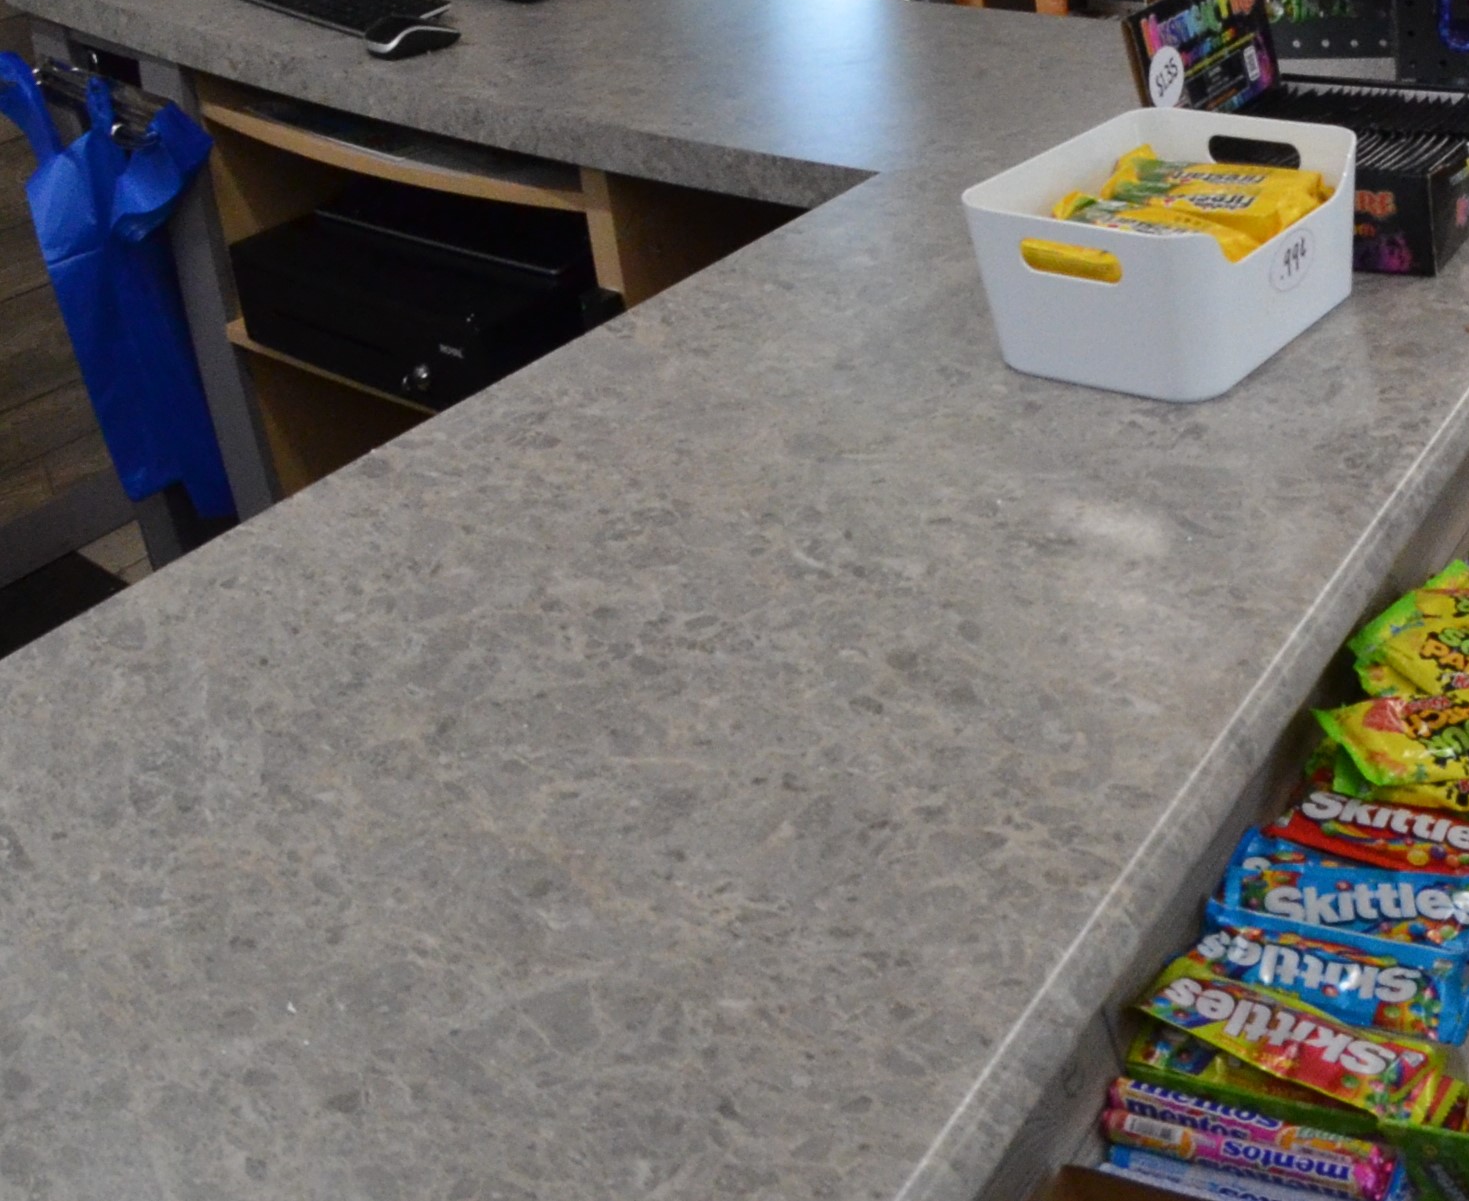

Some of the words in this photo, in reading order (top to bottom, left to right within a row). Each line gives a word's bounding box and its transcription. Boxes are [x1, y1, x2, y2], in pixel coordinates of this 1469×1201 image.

[1196, 930, 1422, 1003] Skittles
[1165, 977, 1397, 1076] Skittles
[1222, 1139, 1350, 1182] mentos
